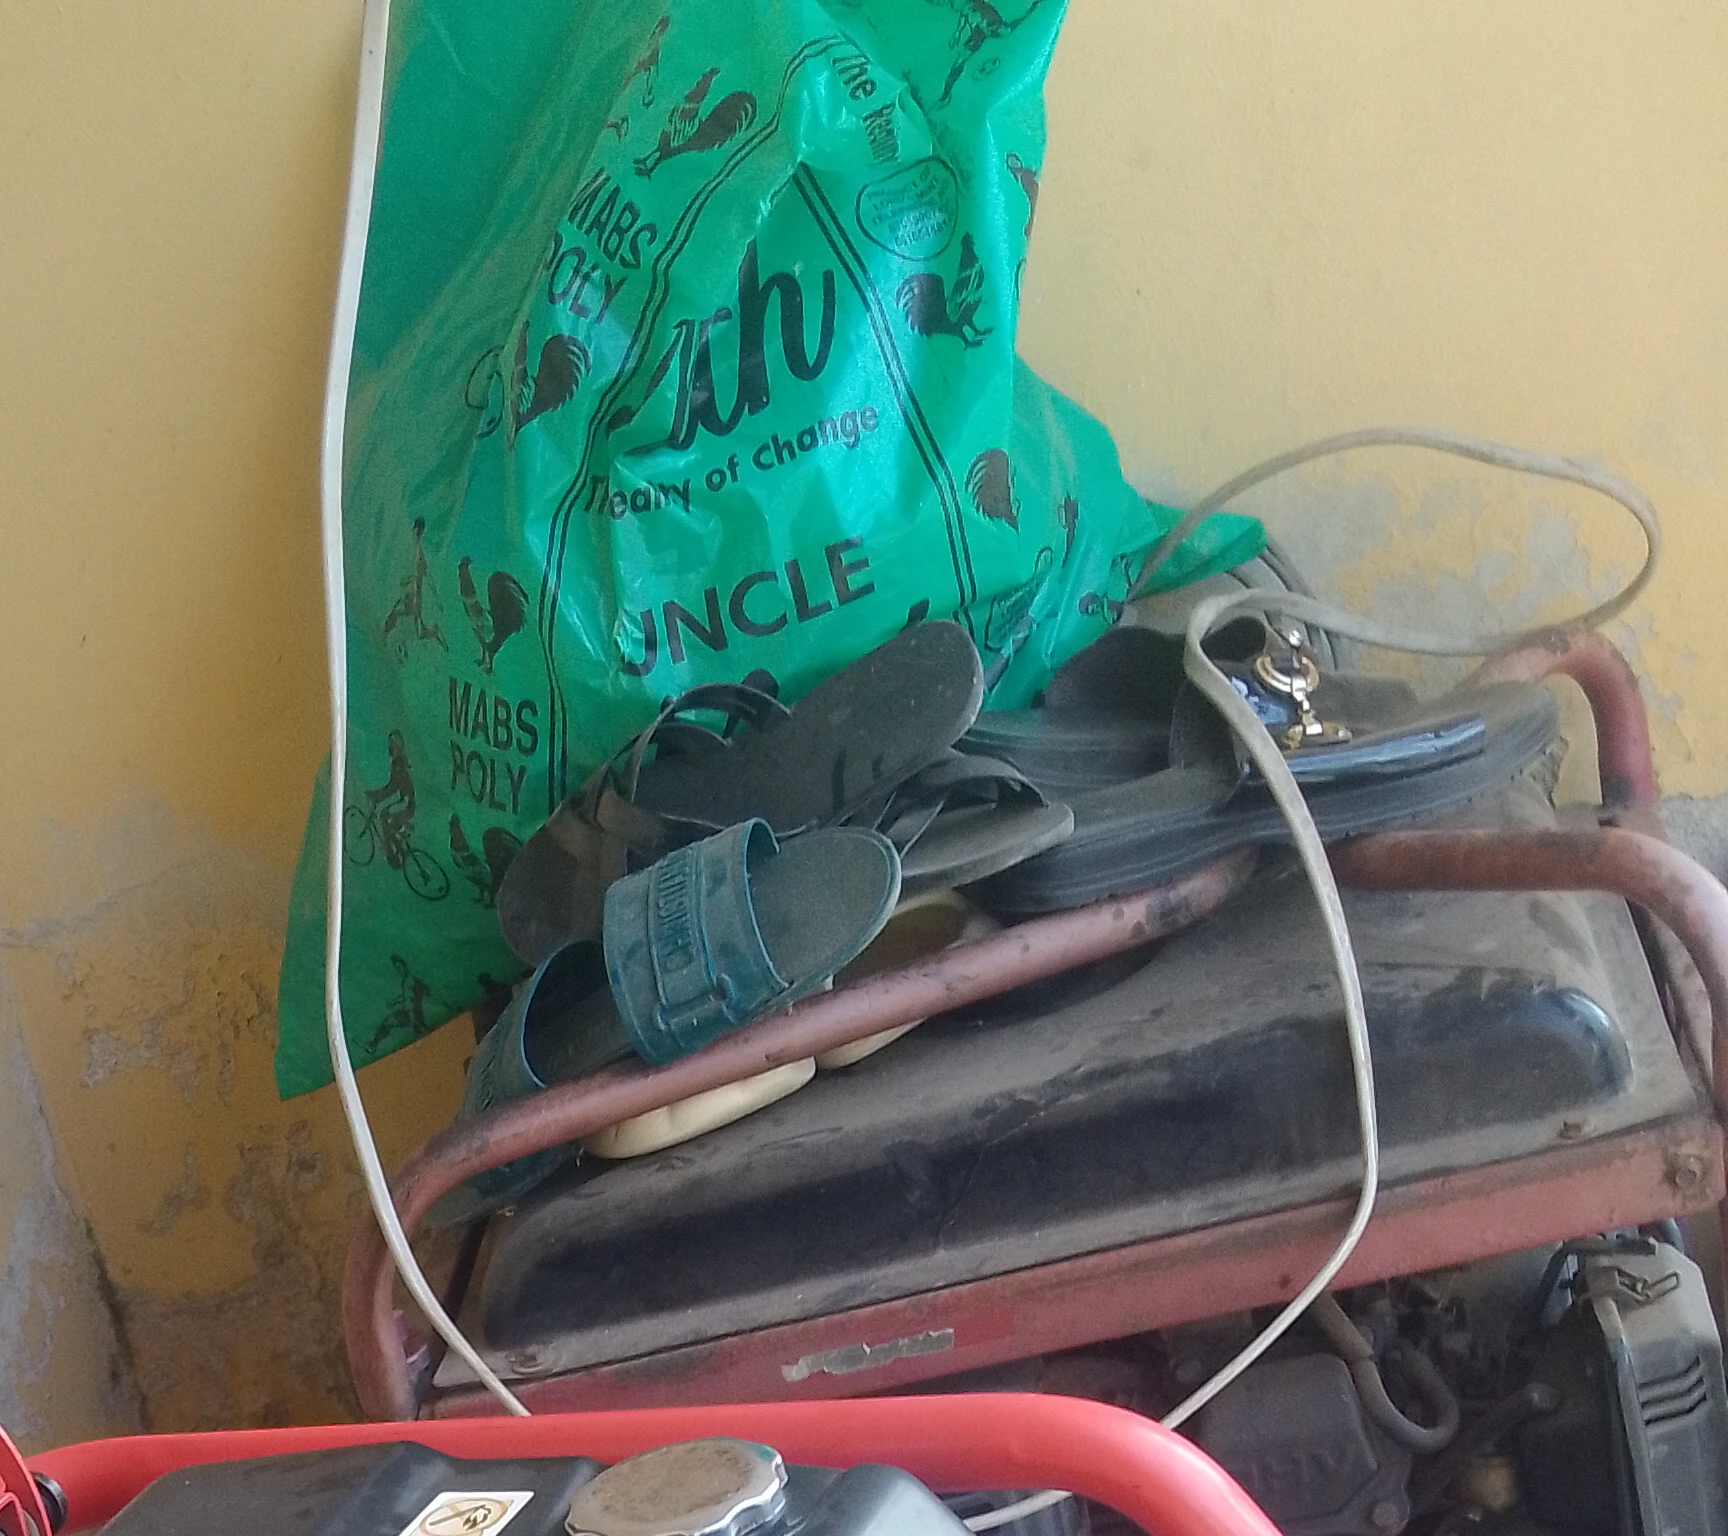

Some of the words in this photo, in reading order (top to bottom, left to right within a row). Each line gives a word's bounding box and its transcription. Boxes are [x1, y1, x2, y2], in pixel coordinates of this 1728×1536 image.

[704, 453, 740, 493] of
[449, 676, 539, 756] MABS
[450, 740, 527, 815] POLY
